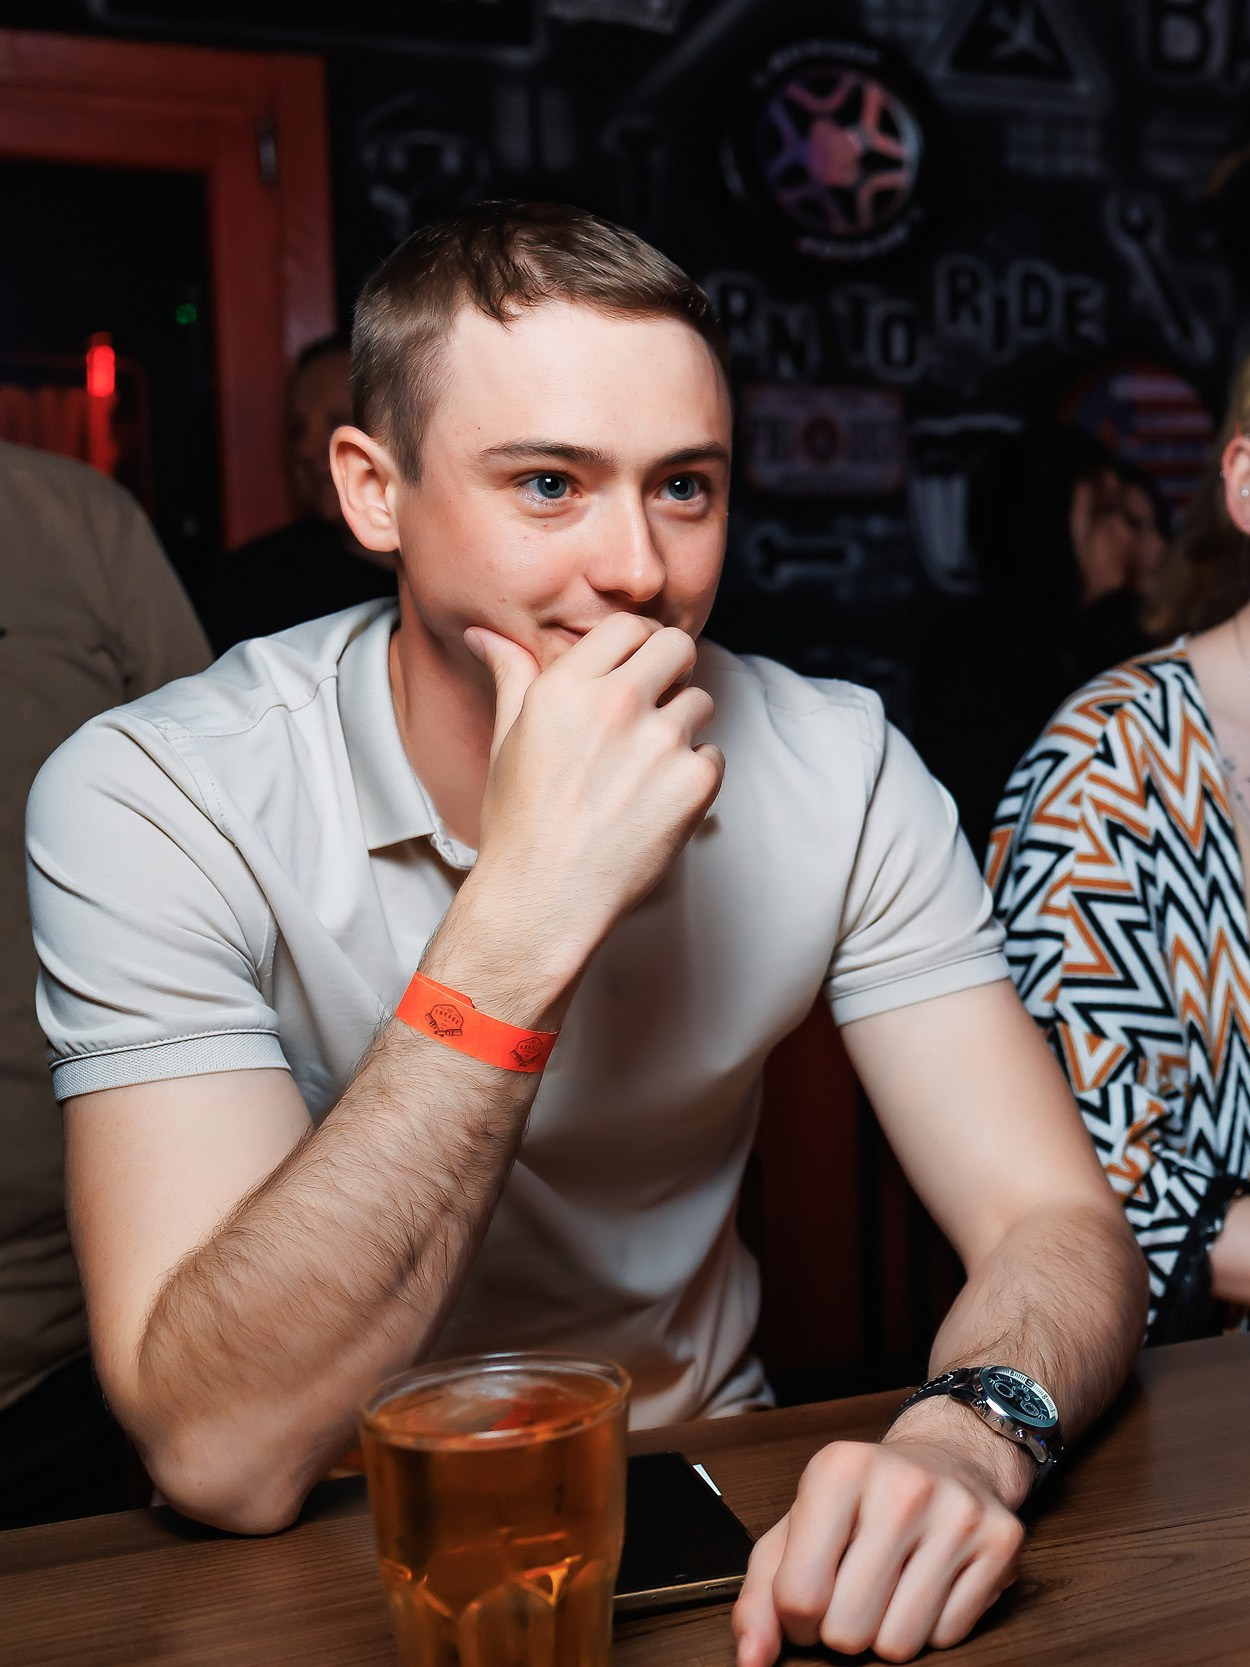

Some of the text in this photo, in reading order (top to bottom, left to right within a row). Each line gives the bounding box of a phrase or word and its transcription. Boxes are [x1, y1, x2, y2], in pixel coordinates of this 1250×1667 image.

[712, 263, 1107, 376] RN TO RIDE
